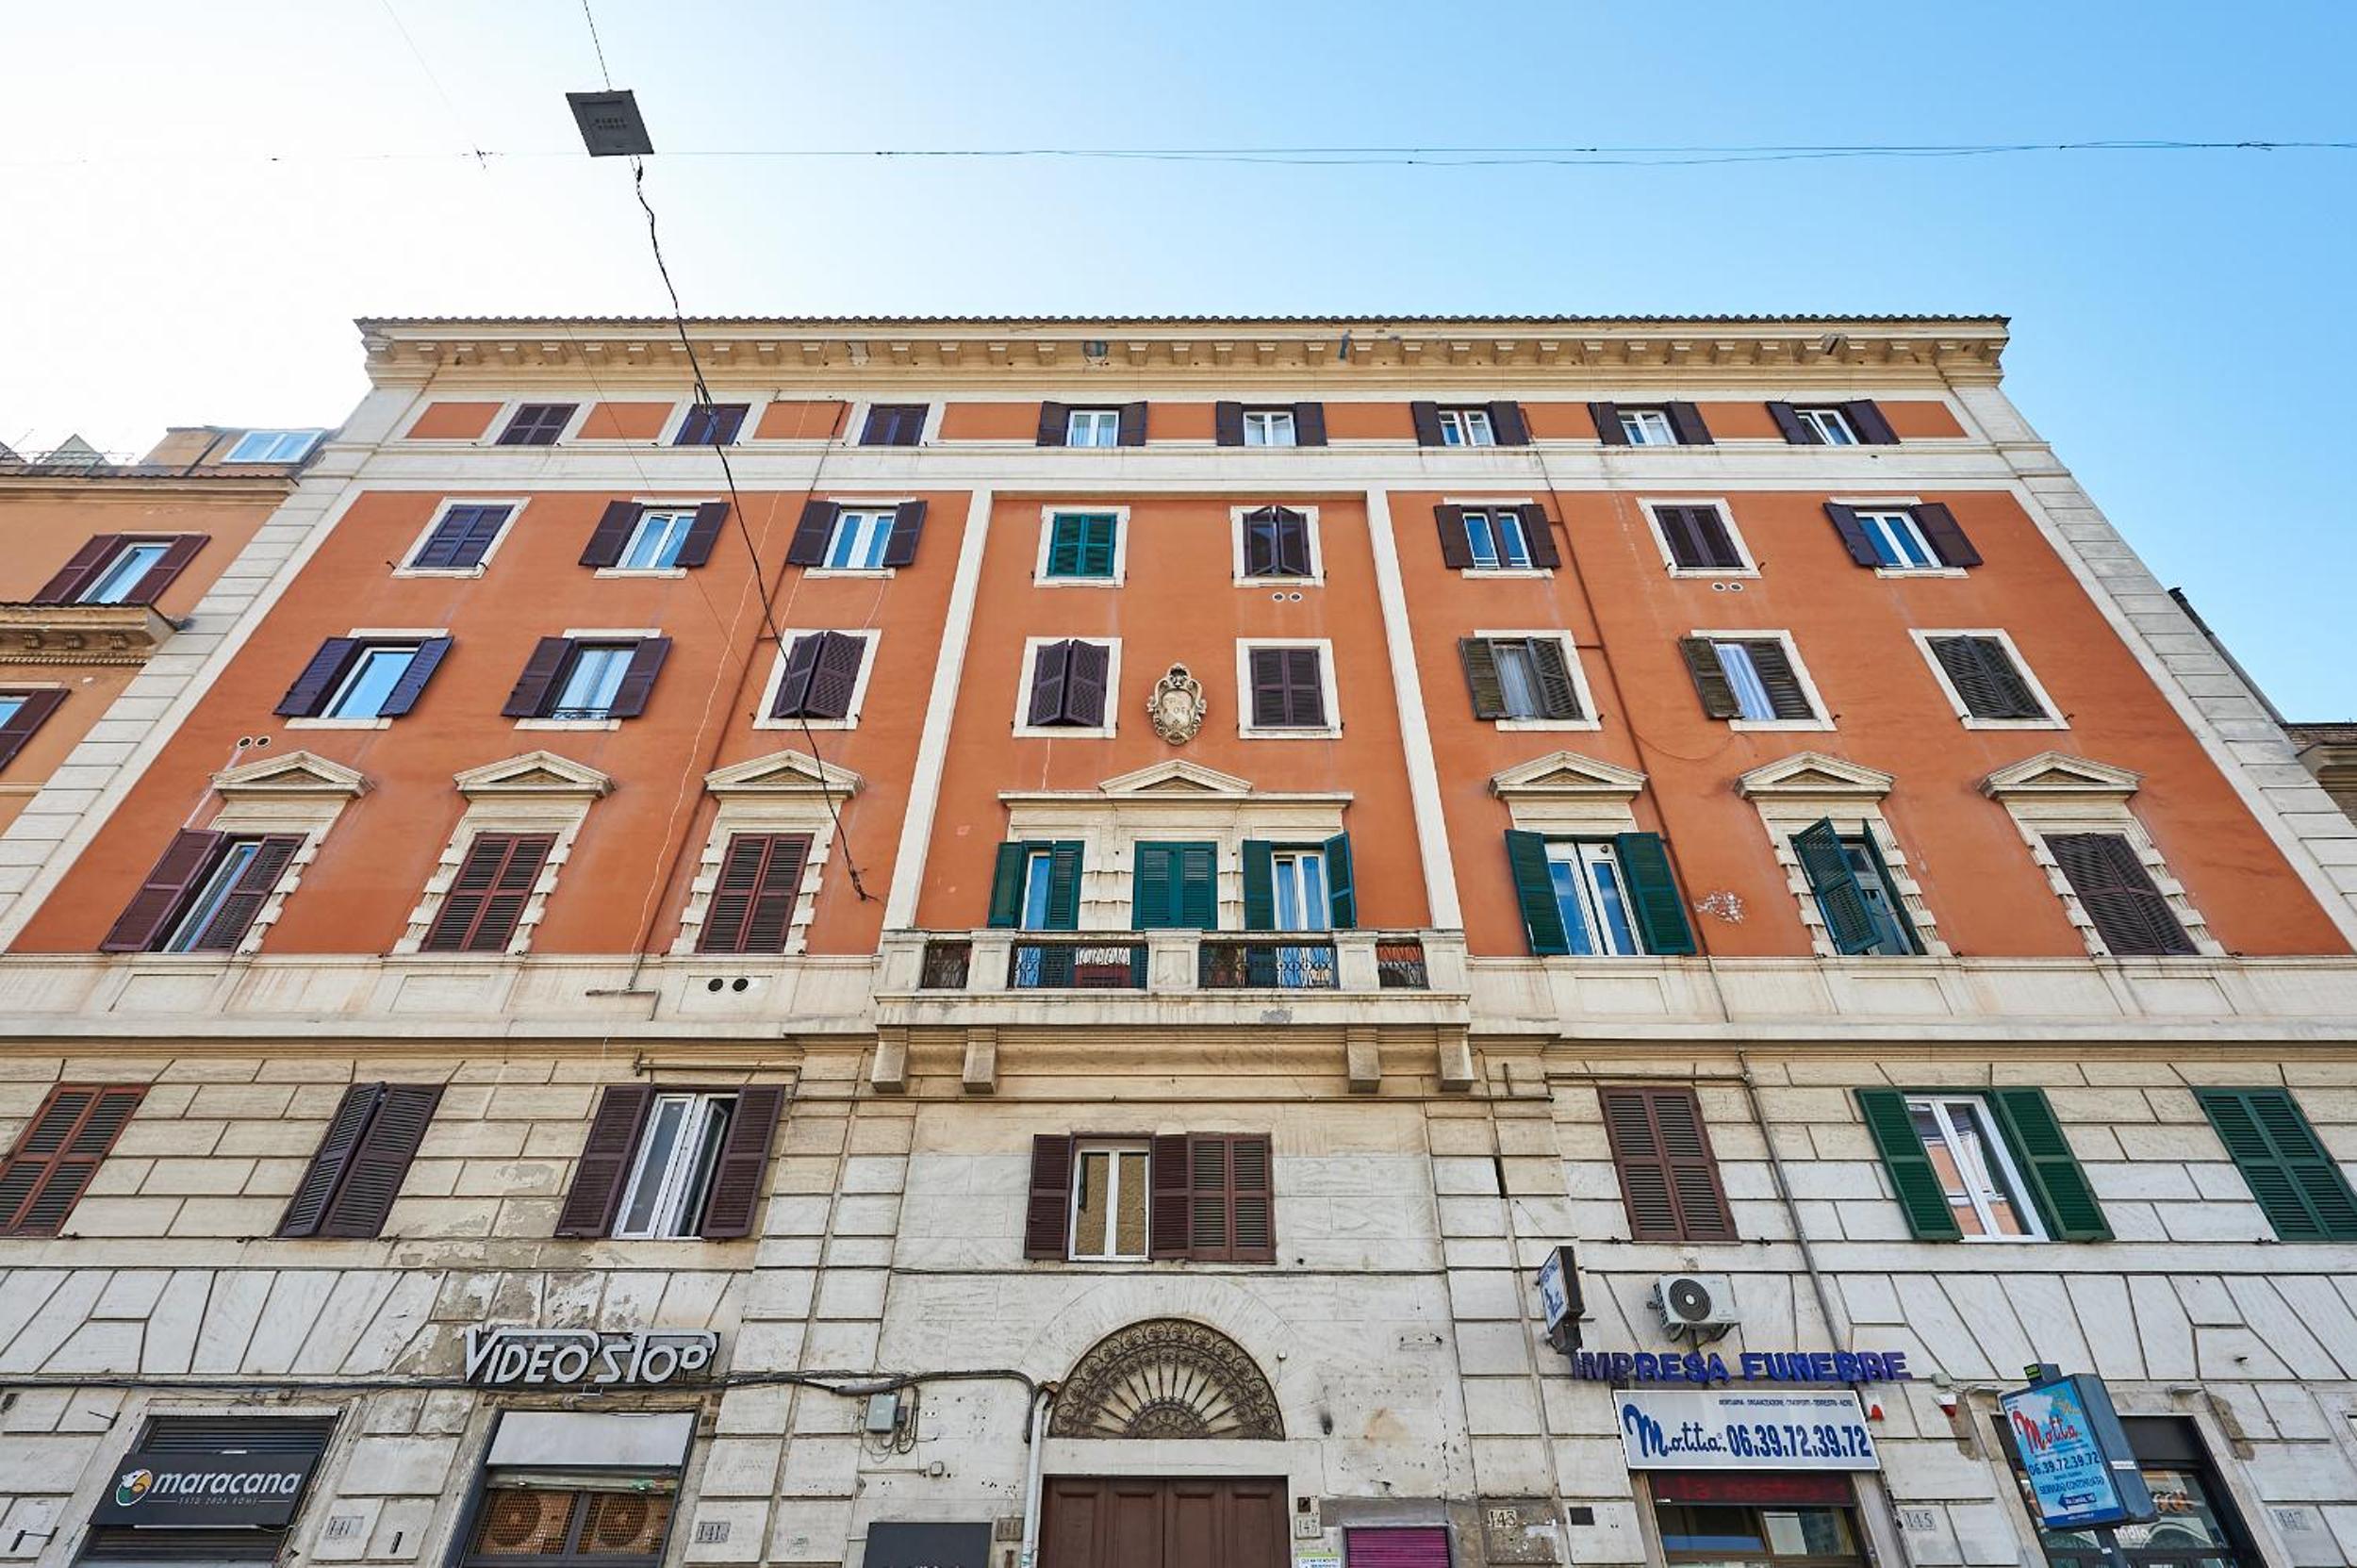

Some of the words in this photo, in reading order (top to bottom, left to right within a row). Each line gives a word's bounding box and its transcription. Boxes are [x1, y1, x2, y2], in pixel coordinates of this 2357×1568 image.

[465, 1325, 600, 1383] VIDEO
[593, 1328, 719, 1383] STOP
[1573, 1351, 1732, 1384] IMPRESA
[1739, 1351, 1913, 1383] FUNEBRE
[1726, 1424, 1872, 1458] 06.39.72.39.72
[2028, 1451, 2102, 1477] 06.39.72.39.72
[152, 1472, 303, 1494] maracana
[1905, 1512, 1934, 1528] 145
